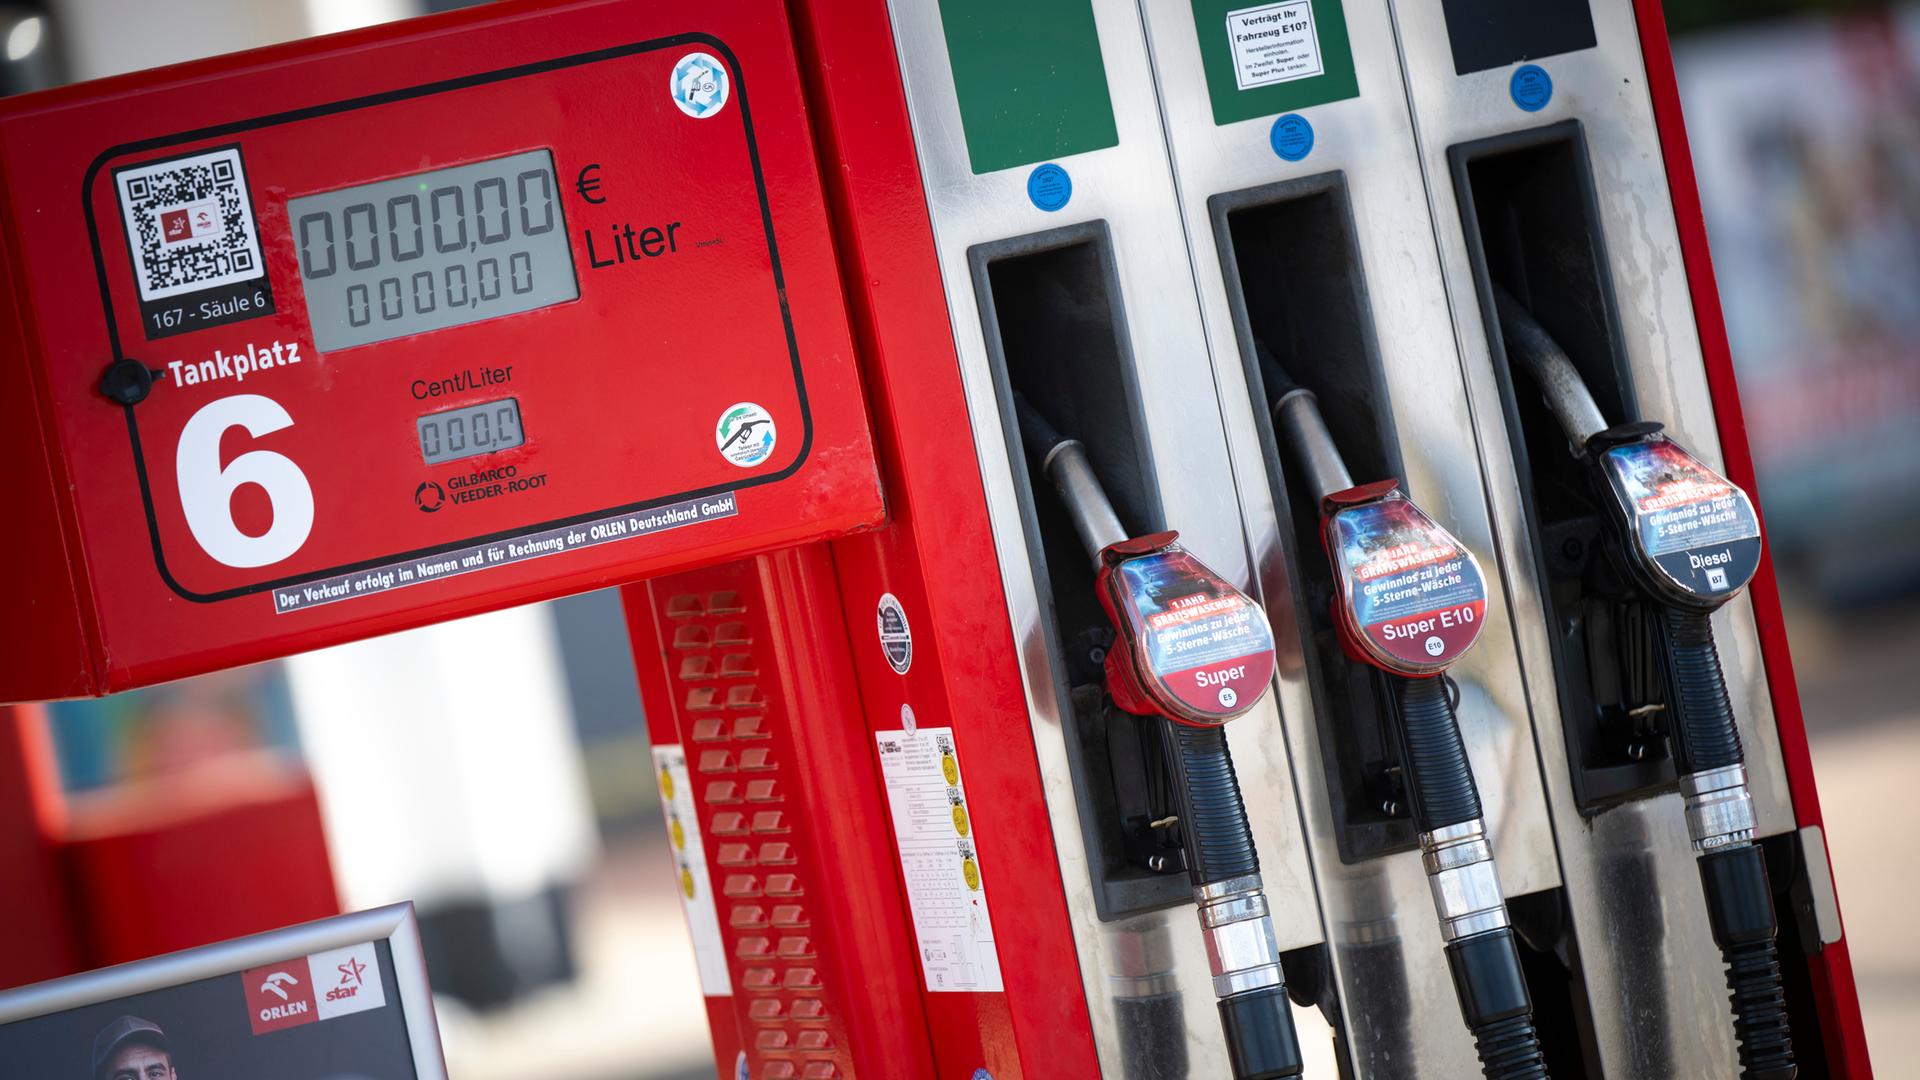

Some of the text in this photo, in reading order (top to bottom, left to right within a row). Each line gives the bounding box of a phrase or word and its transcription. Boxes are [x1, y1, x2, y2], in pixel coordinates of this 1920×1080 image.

[1236, 21, 1308, 43] Fahrzeug E10?
[1242, 10, 1297, 27] Verträgt Ihr
[1251, 70, 1270, 78] Super
[1271, 66, 1285, 74] Plus
[1276, 56, 1295, 65] Super
[576, 164, 606, 205] €
[584, 221, 681, 269] Liter
[152, 308, 183, 330] 167
[200, 297, 249, 320] Säule
[254, 291, 266, 308] 6
[168, 340, 301, 388] Tankplatz
[411, 366, 513, 400] Cent/Liter
[176, 393, 315, 569] 6
[447, 465, 517, 490] GILBARCO
[450, 474, 548, 505] VEEDER-ROOT
[1650, 498, 1737, 526] Gewinnlos zu jeder
[1658, 510, 1737, 537] 5-Sterne-Wäsche
[279, 498, 734, 608] Der Verkauf erfolgt im Namen und für Rechnung der ORLEN Deutschland GmbH
[1690, 548, 1733, 569] Diesel
[1363, 561, 1463, 596] Gewinnlos zu jeder
[1373, 574, 1462, 607] 5-Sterne-Wäsche
[1712, 575, 1723, 584] B7
[1180, 594, 1206, 609] JAHR
[1157, 611, 1251, 644] Gewinnlos zu jeder
[1382, 606, 1474, 640] Super E10
[1167, 625, 1251, 655] 5-Sterne-Wäsche
[1428, 641, 1442, 651] E10
[1195, 664, 1246, 688] Super
[1223, 693, 1233, 701] E5
[325, 985, 359, 1002] star
[260, 1000, 308, 1022] ORLEN
